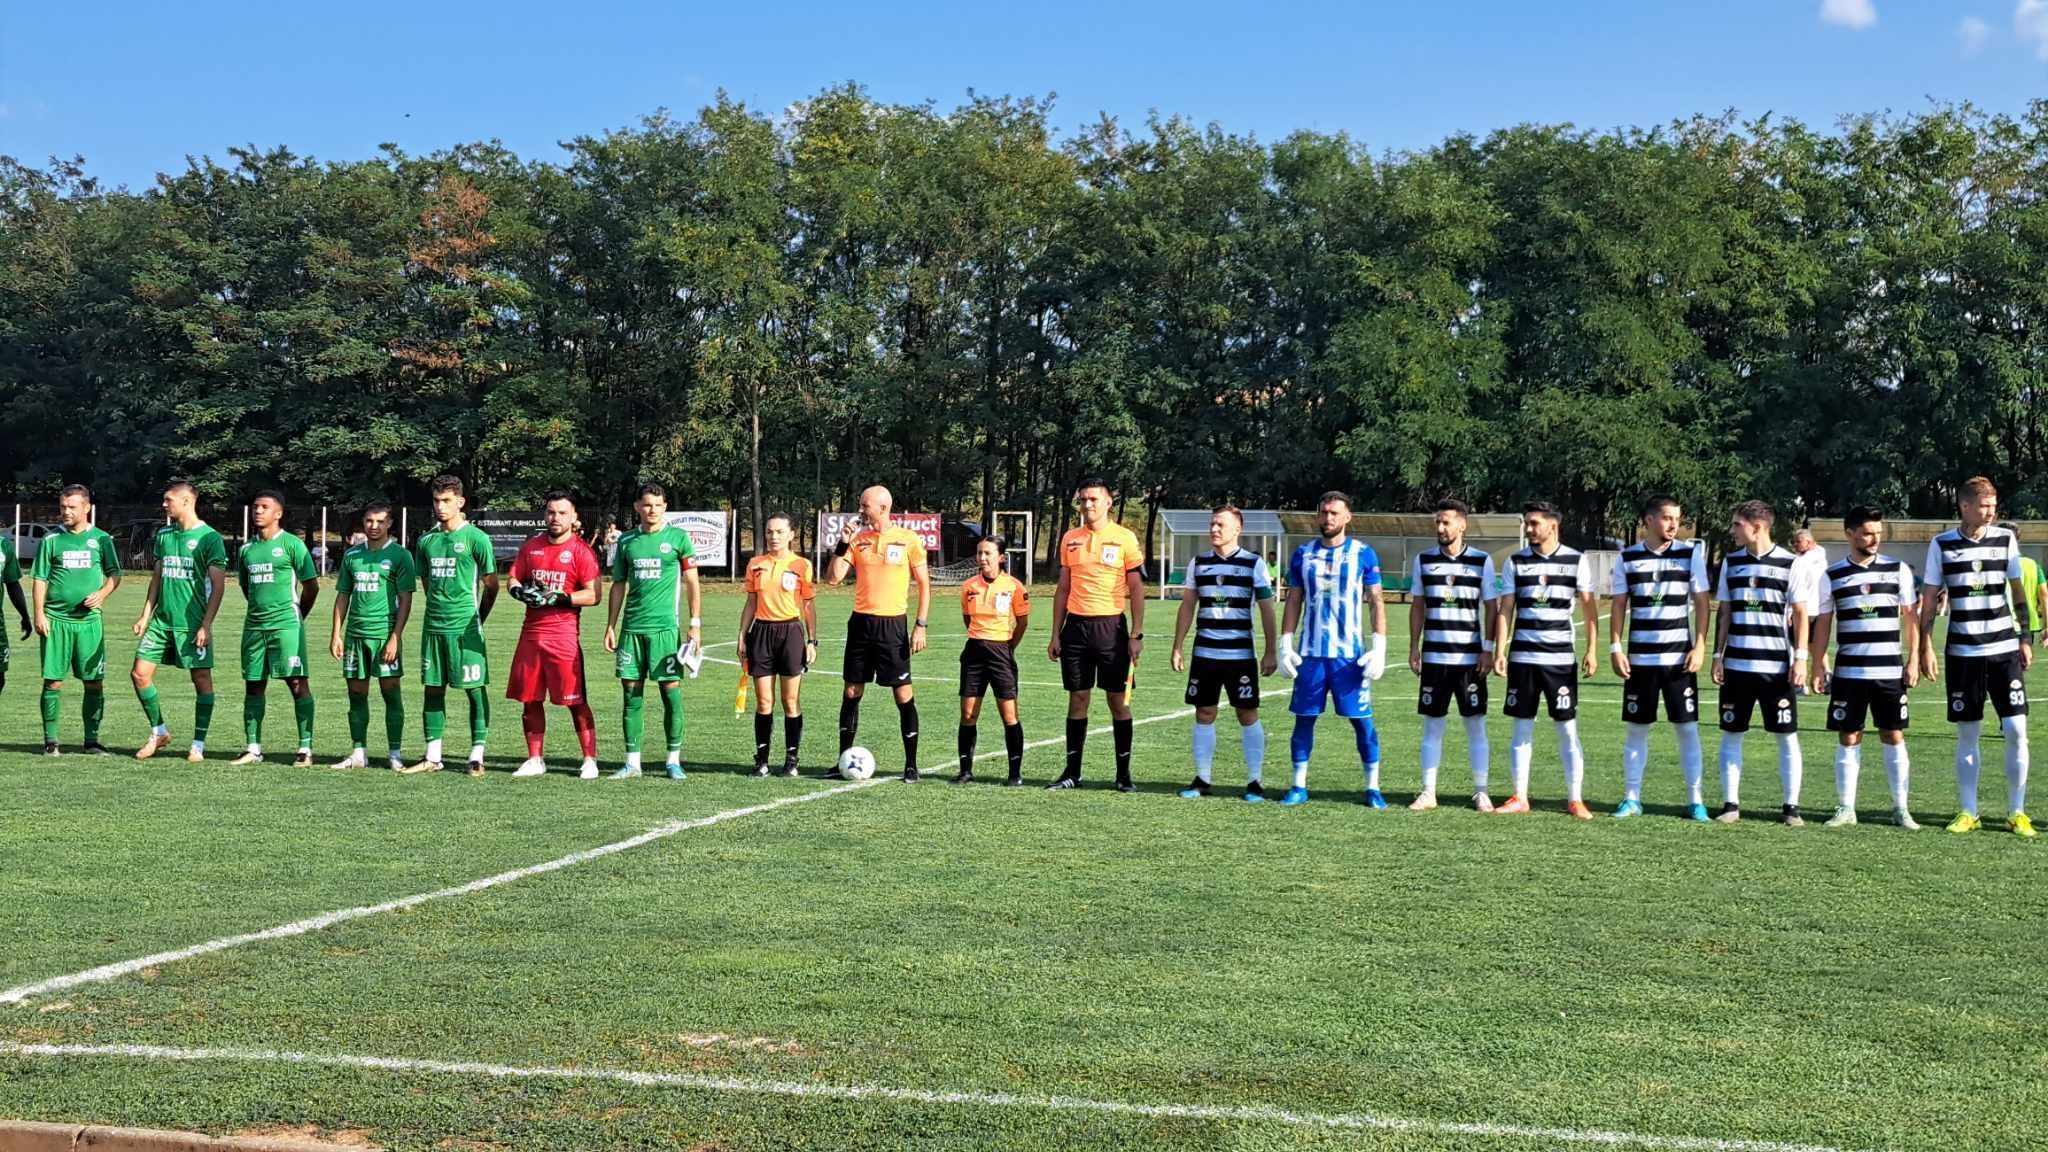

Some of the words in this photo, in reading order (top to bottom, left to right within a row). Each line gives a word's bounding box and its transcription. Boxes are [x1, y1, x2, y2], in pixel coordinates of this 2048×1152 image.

[462, 664, 481, 682] 18
[666, 657, 676, 674] 2
[1238, 686, 1253, 699] 22
[2009, 690, 2025, 706] 93
[1470, 694, 1479, 707] 9
[1556, 695, 1571, 709] 10
[1685, 698, 1695, 713] 6
[1777, 709, 1792, 724] 16
[1900, 705, 1908, 720] 8
